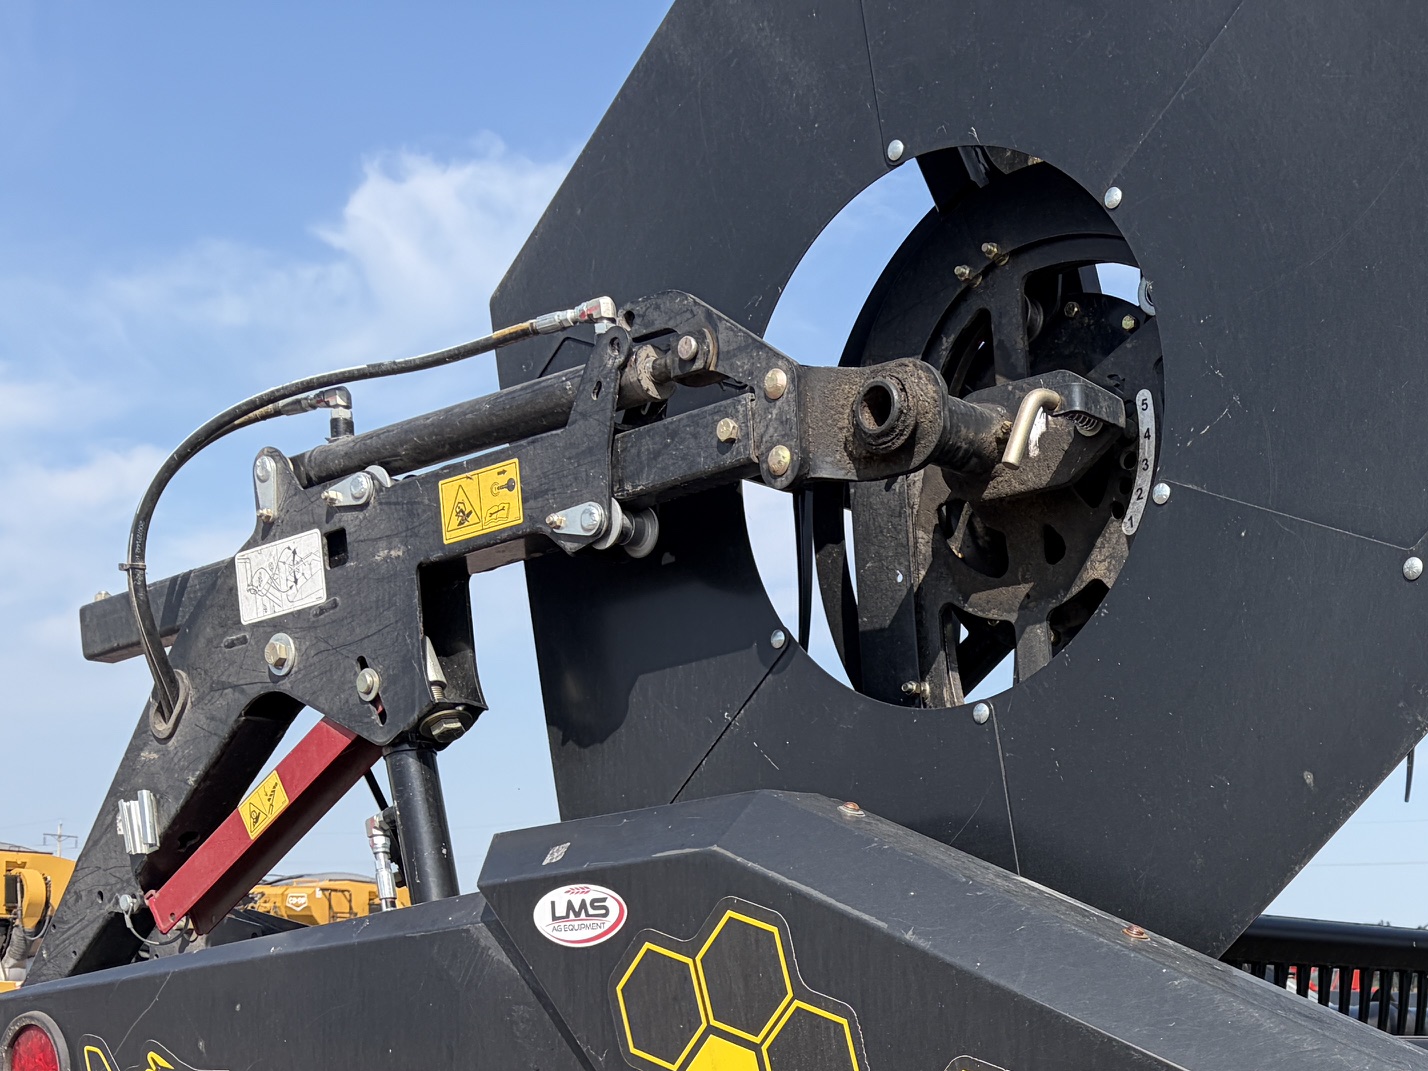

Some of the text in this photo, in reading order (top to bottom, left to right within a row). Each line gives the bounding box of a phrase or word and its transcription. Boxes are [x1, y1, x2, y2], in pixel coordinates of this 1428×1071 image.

[1141, 398, 1149, 411] 5
[1143, 427, 1151, 441] 4
[1141, 458, 1149, 471] 3
[1136, 487, 1143, 501] 2
[1127, 515, 1134, 528] 1
[550, 897, 610, 922] LMS
[552, 922, 606, 932] AG EQUIPMENT
